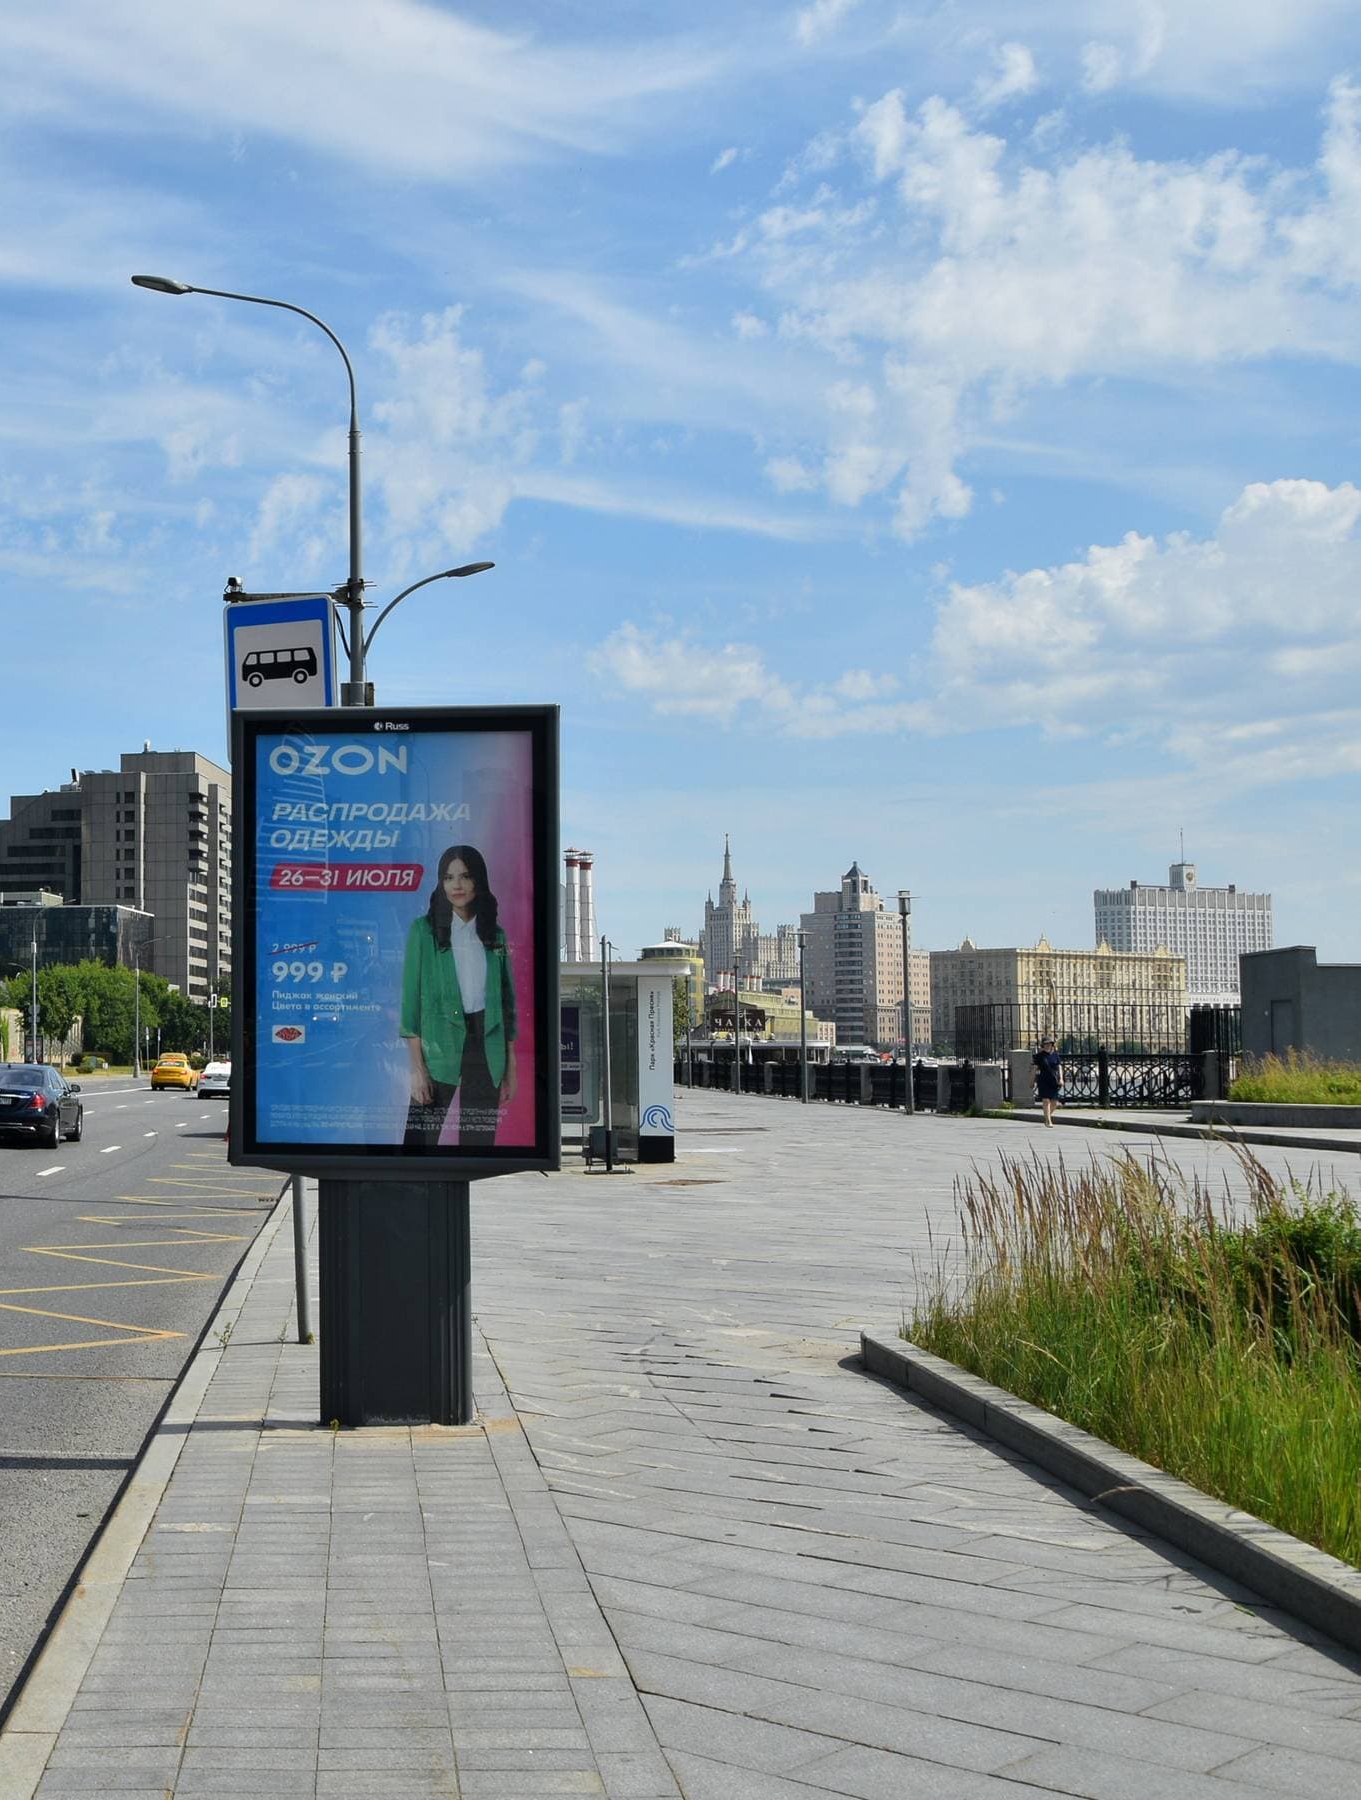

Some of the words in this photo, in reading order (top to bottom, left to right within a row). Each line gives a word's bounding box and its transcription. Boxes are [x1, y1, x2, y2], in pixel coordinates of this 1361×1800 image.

[385, 721, 409, 731] Russ
[269, 744, 408, 776] OZON
[272, 802, 471, 824] РАСПРОДАЖА
[270, 829, 401, 851] ОДЕЖДЫ
[345, 869, 415, 886] ИЮЛЯ
[272, 961, 324, 983] 999
[272, 990, 311, 1000] Пиджак
[315, 991, 358, 1000] женский
[272, 1001, 304, 1011] Цвета
[313, 1003, 382, 1012] ассортименте
[715, 1018, 762, 1027] ЧАКА
